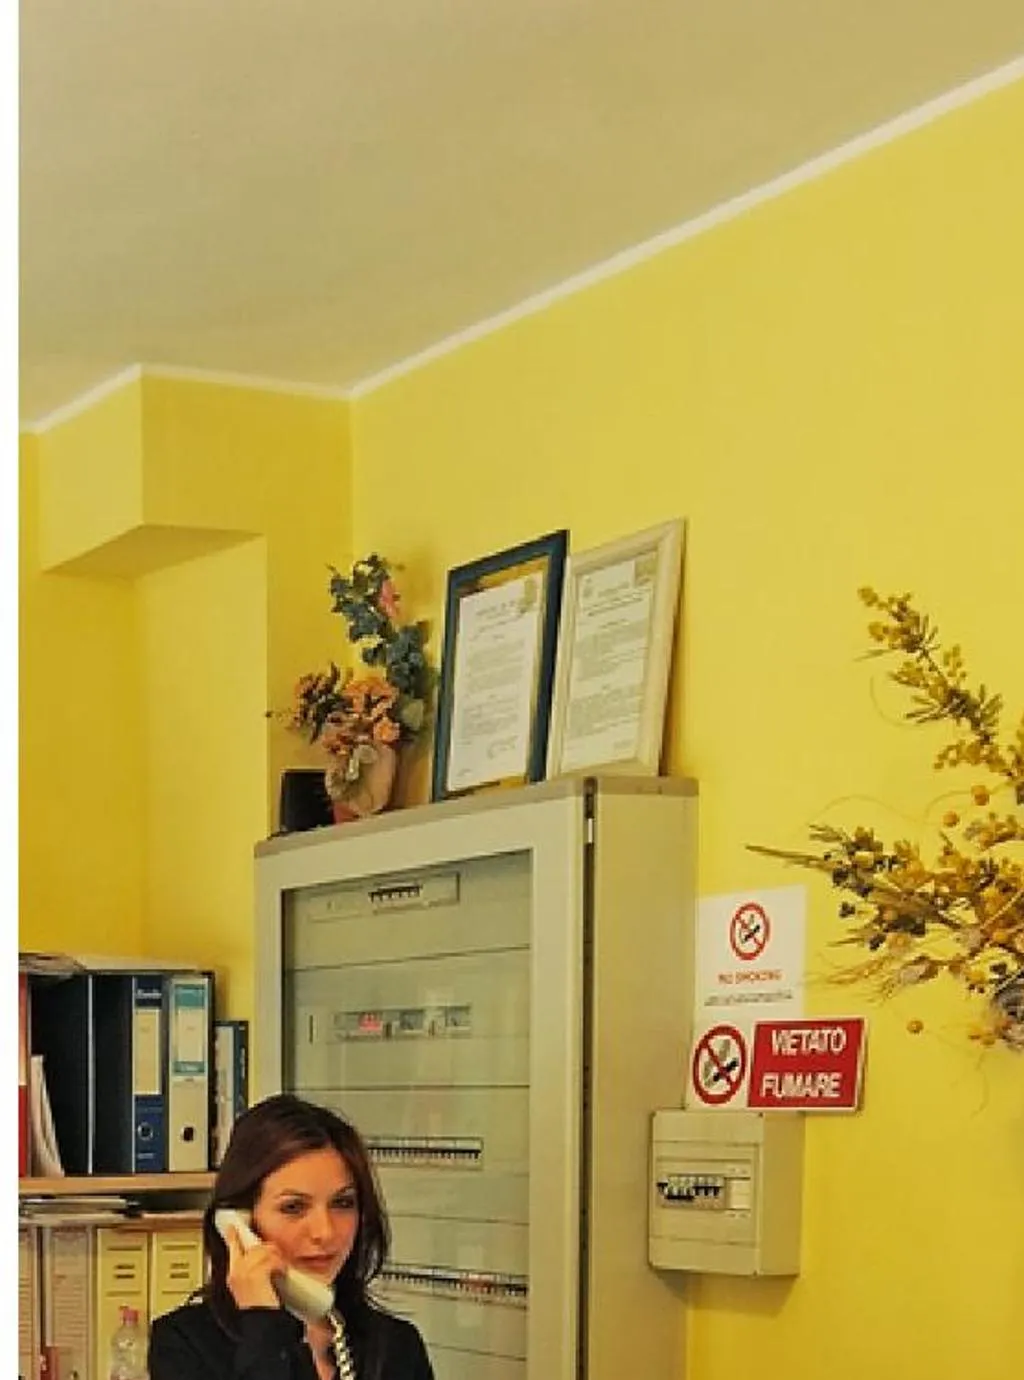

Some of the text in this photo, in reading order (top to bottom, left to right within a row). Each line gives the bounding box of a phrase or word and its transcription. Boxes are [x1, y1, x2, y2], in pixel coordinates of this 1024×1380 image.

[718, 969, 783, 985] NO SMOKING
[771, 1027, 847, 1056] VIETATO
[760, 1071, 842, 1099] FUMARE
